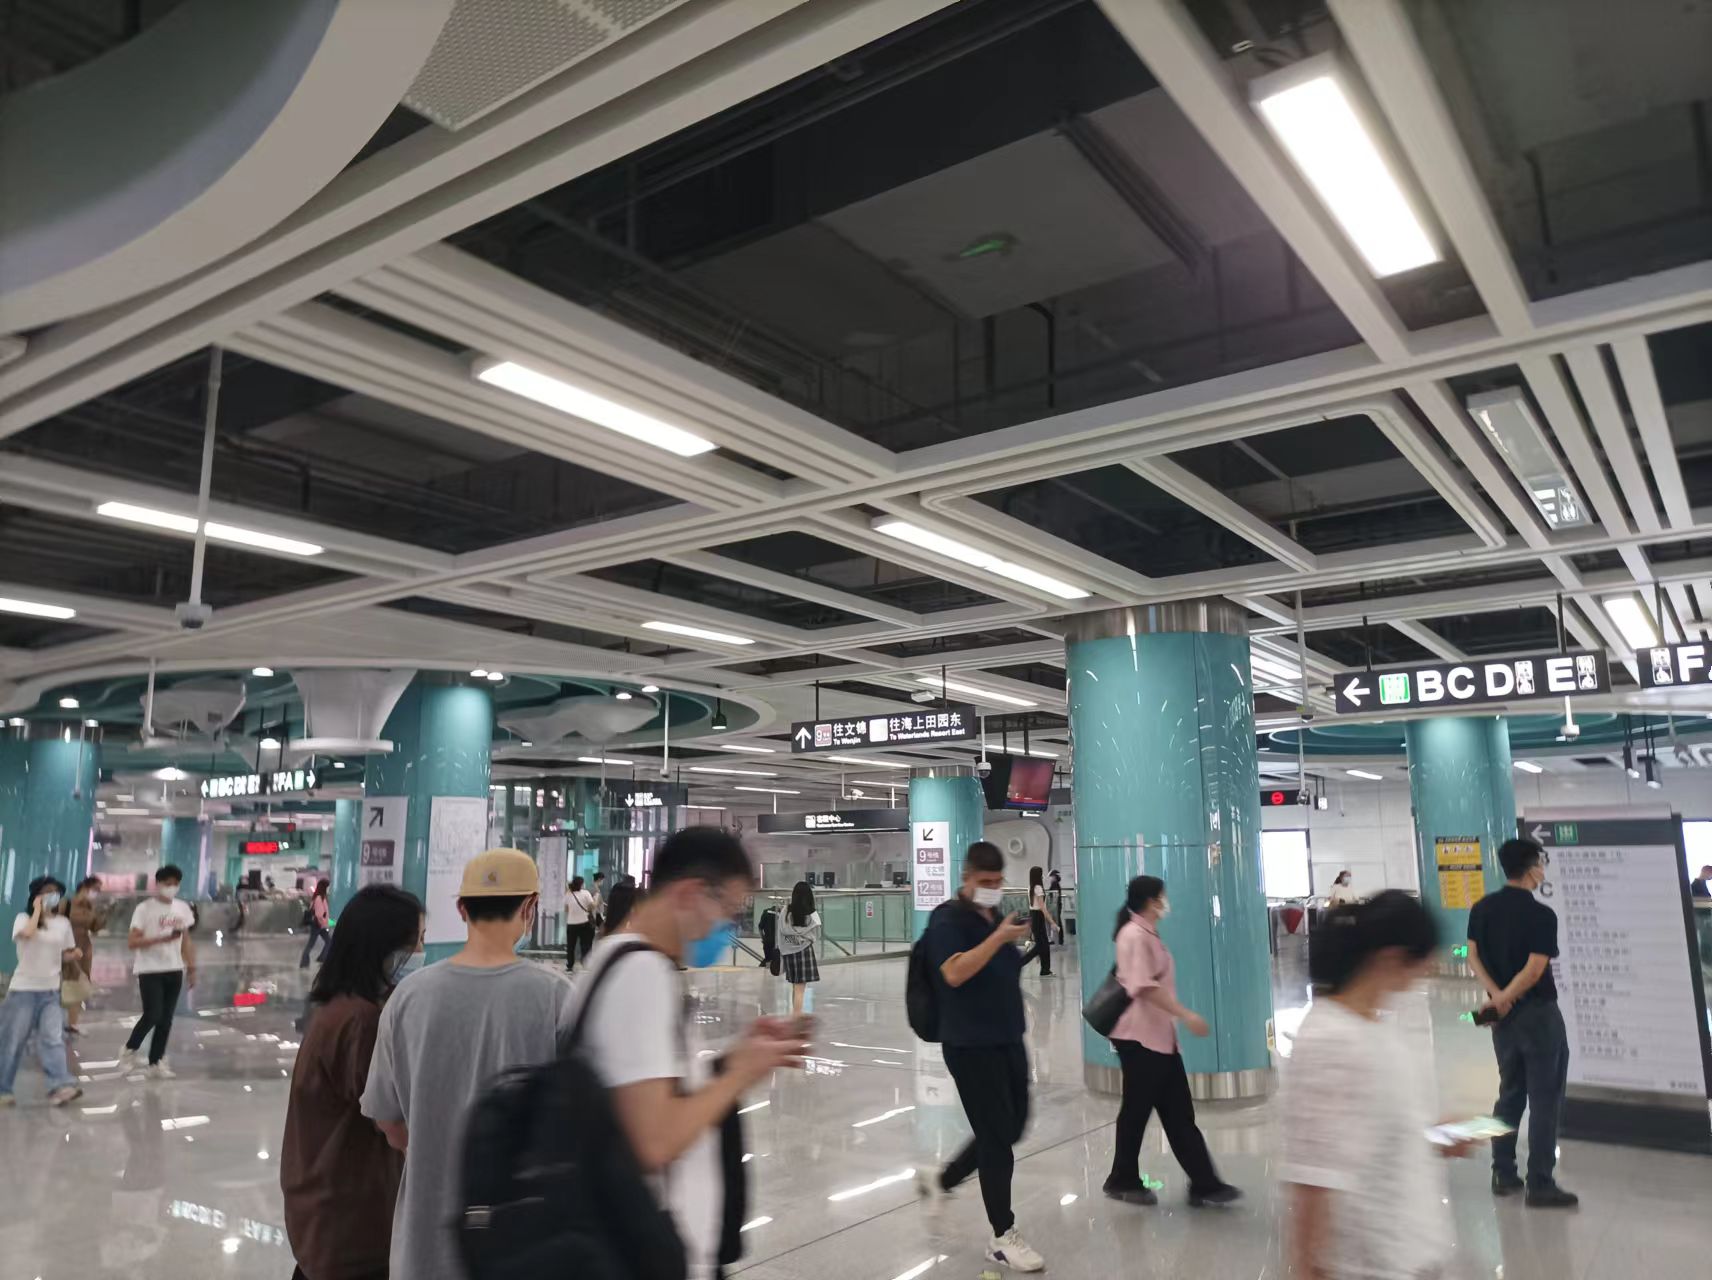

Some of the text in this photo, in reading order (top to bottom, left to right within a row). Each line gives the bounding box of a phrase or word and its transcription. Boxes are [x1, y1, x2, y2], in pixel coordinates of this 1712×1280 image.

[1677, 645, 1705, 682] F
[1546, 657, 1577, 692] E
[833, 720, 867, 738] 往文锦
[889, 712, 962, 732] 往海上田园东
[816, 729, 823, 742] 9
[930, 729, 951, 737] Resort
[951, 727, 965, 736] East
[919, 849, 927, 862] 9
[1540, 882, 1554, 898] C
